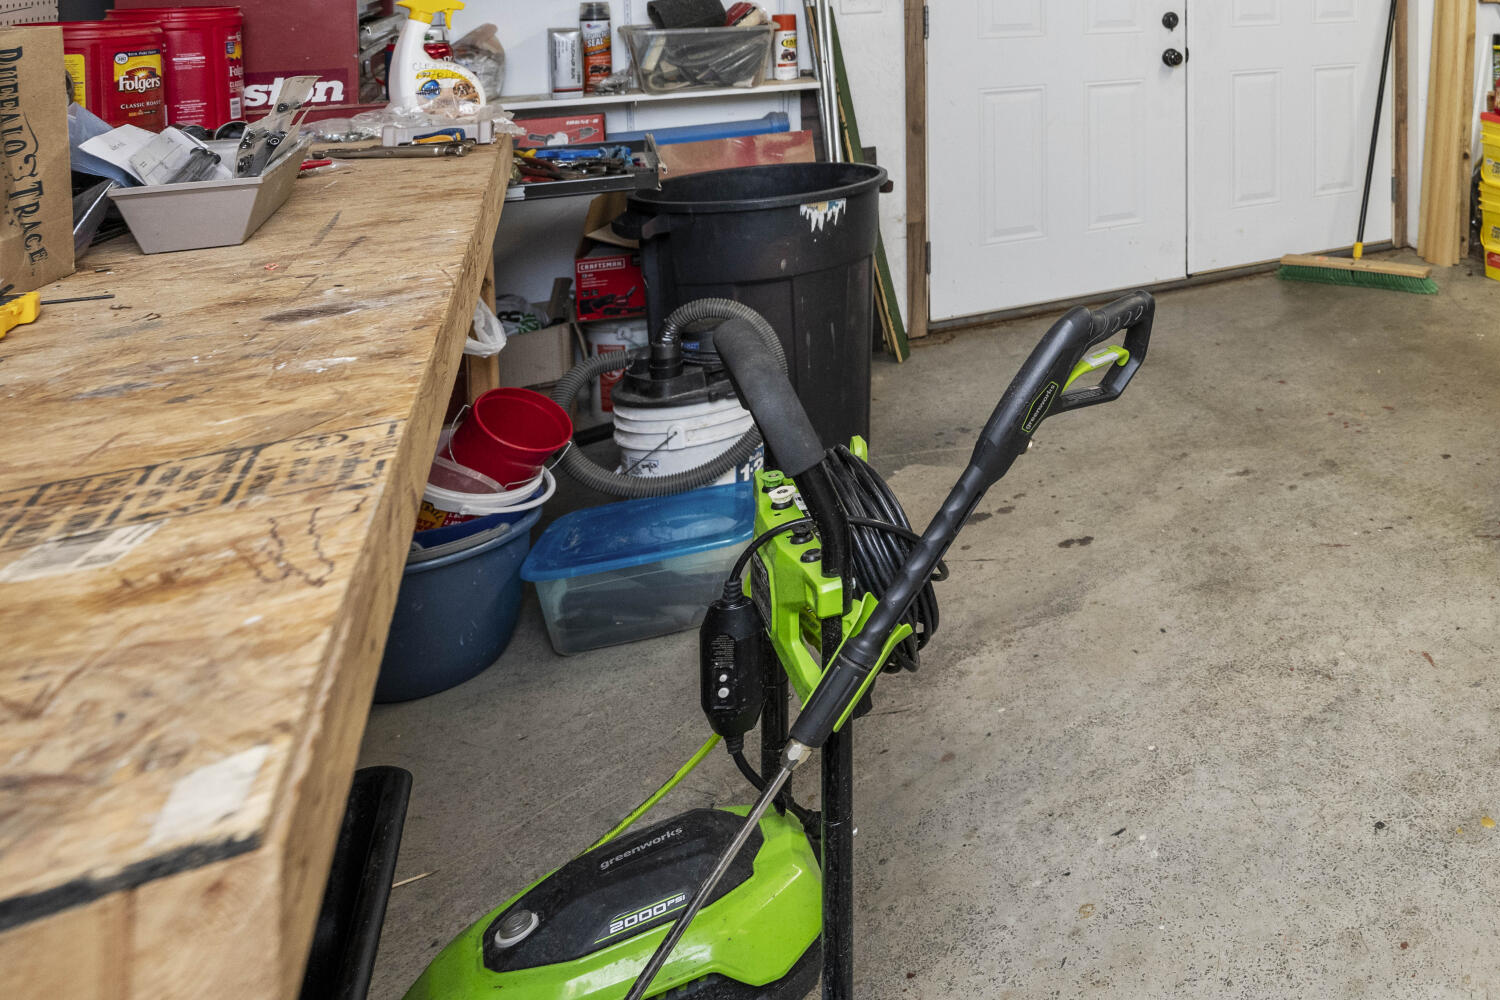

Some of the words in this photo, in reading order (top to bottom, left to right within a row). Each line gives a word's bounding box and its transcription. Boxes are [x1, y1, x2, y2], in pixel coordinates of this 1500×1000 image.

[118, 74, 161, 93] Folgers
[120, 101, 145, 110] CLASSIC
[9, 180, 49, 266] TRACE
[580, 261, 623, 271] CRAFTSMAN
[600, 827, 683, 871] greenworks
[609, 904, 667, 934] 2000
[667, 894, 686, 907] PSI
